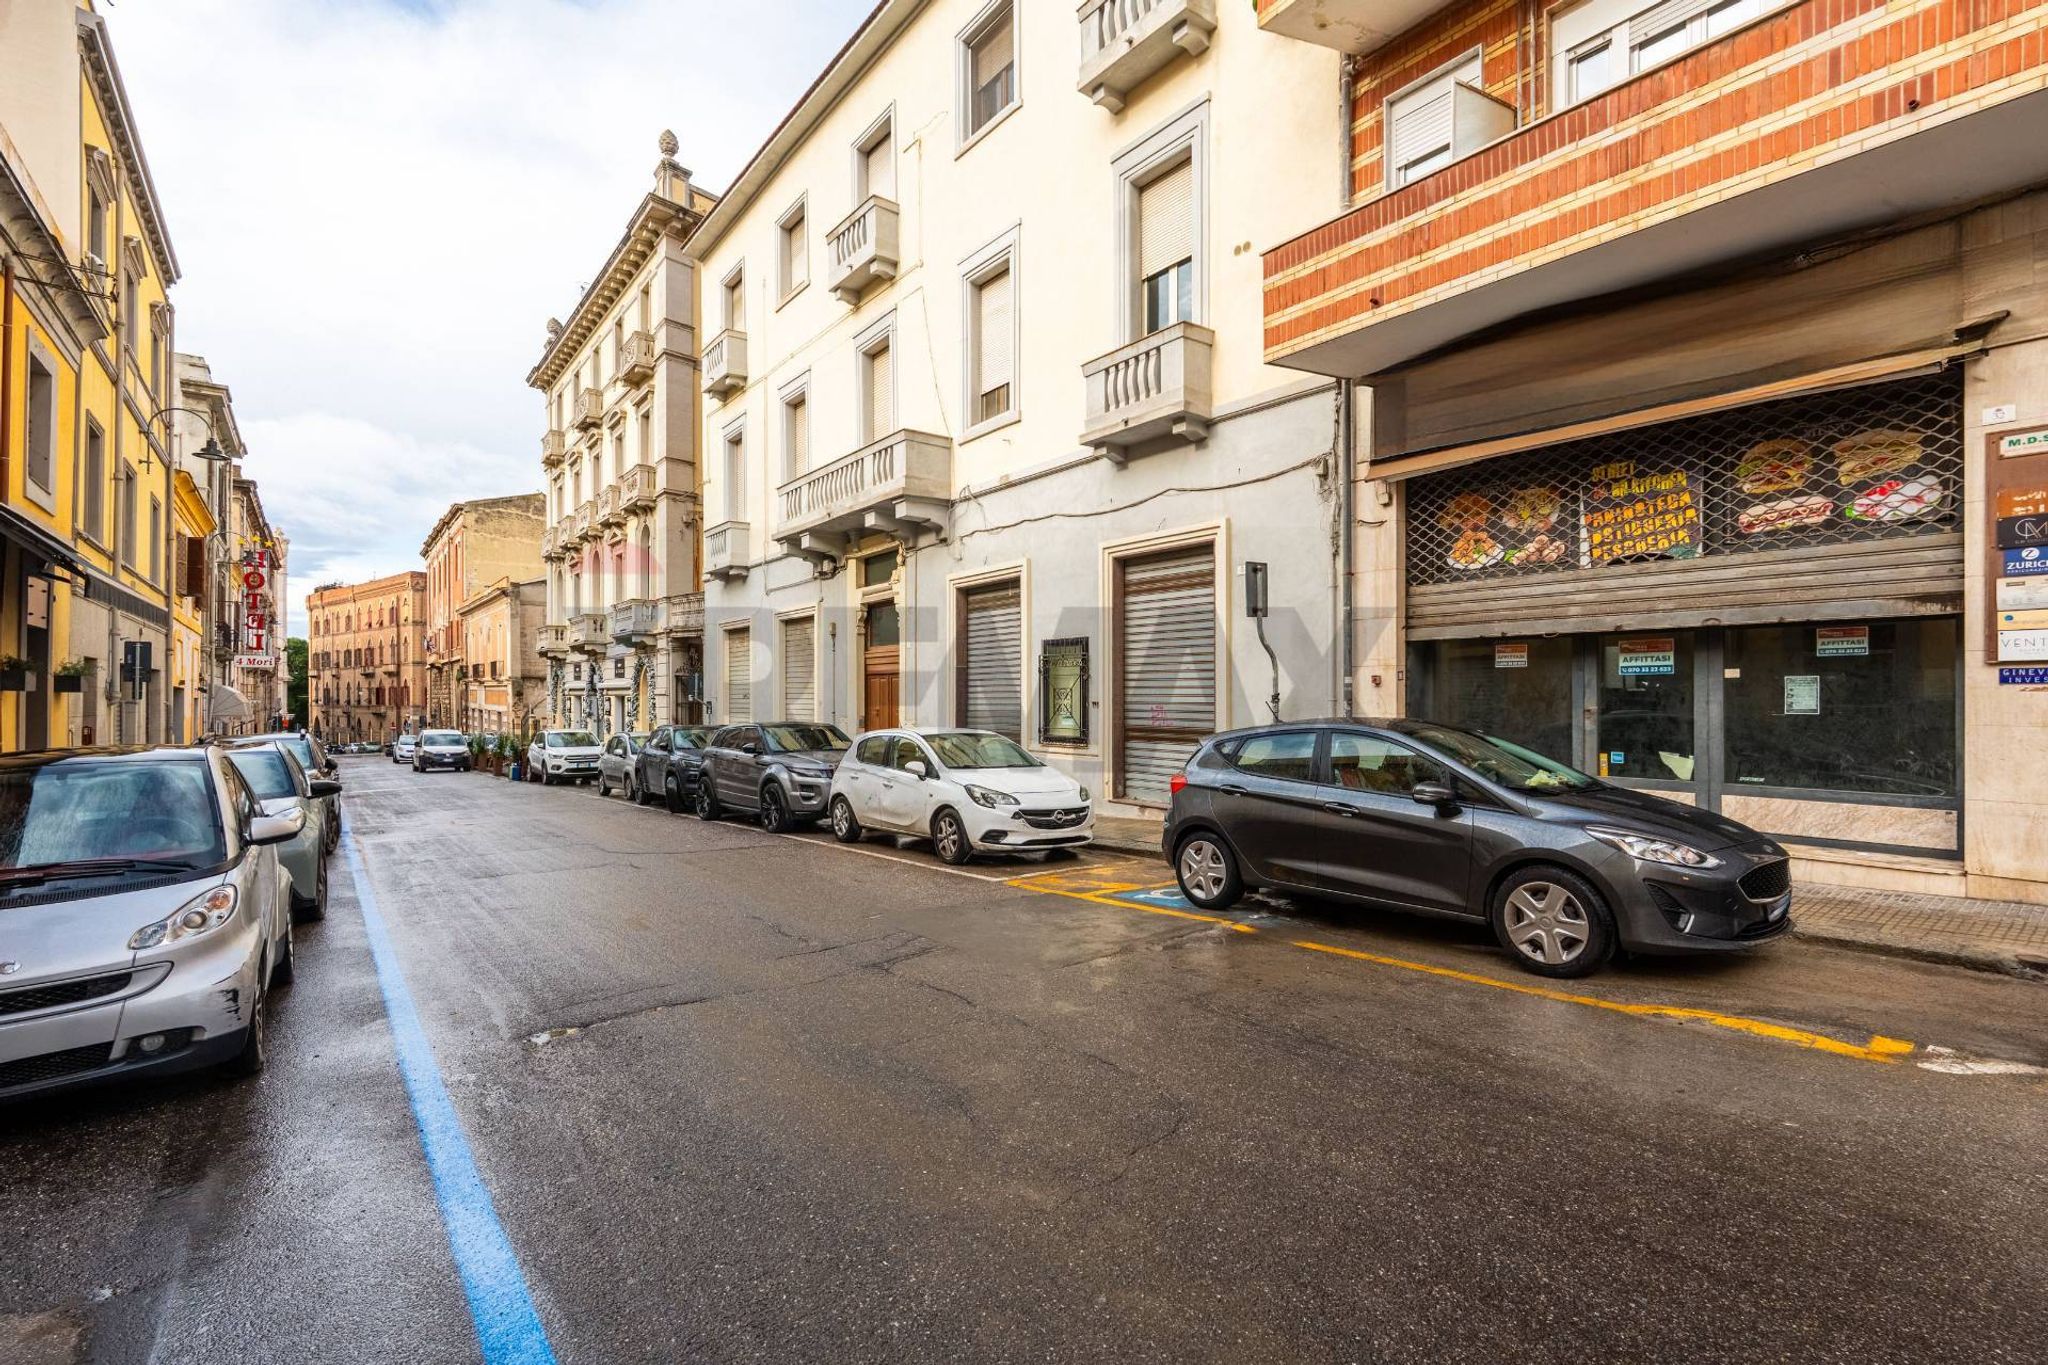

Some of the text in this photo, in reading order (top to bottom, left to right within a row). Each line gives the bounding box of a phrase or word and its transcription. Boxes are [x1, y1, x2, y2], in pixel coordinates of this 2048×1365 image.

[2007, 559, 2048, 570] ZURIC
[244, 551, 266, 651] HOTEL
[246, 658, 273, 666] Mori
[1622, 655, 1671, 663] AFFITTASI
[2002, 668, 2048, 676] GINEV
